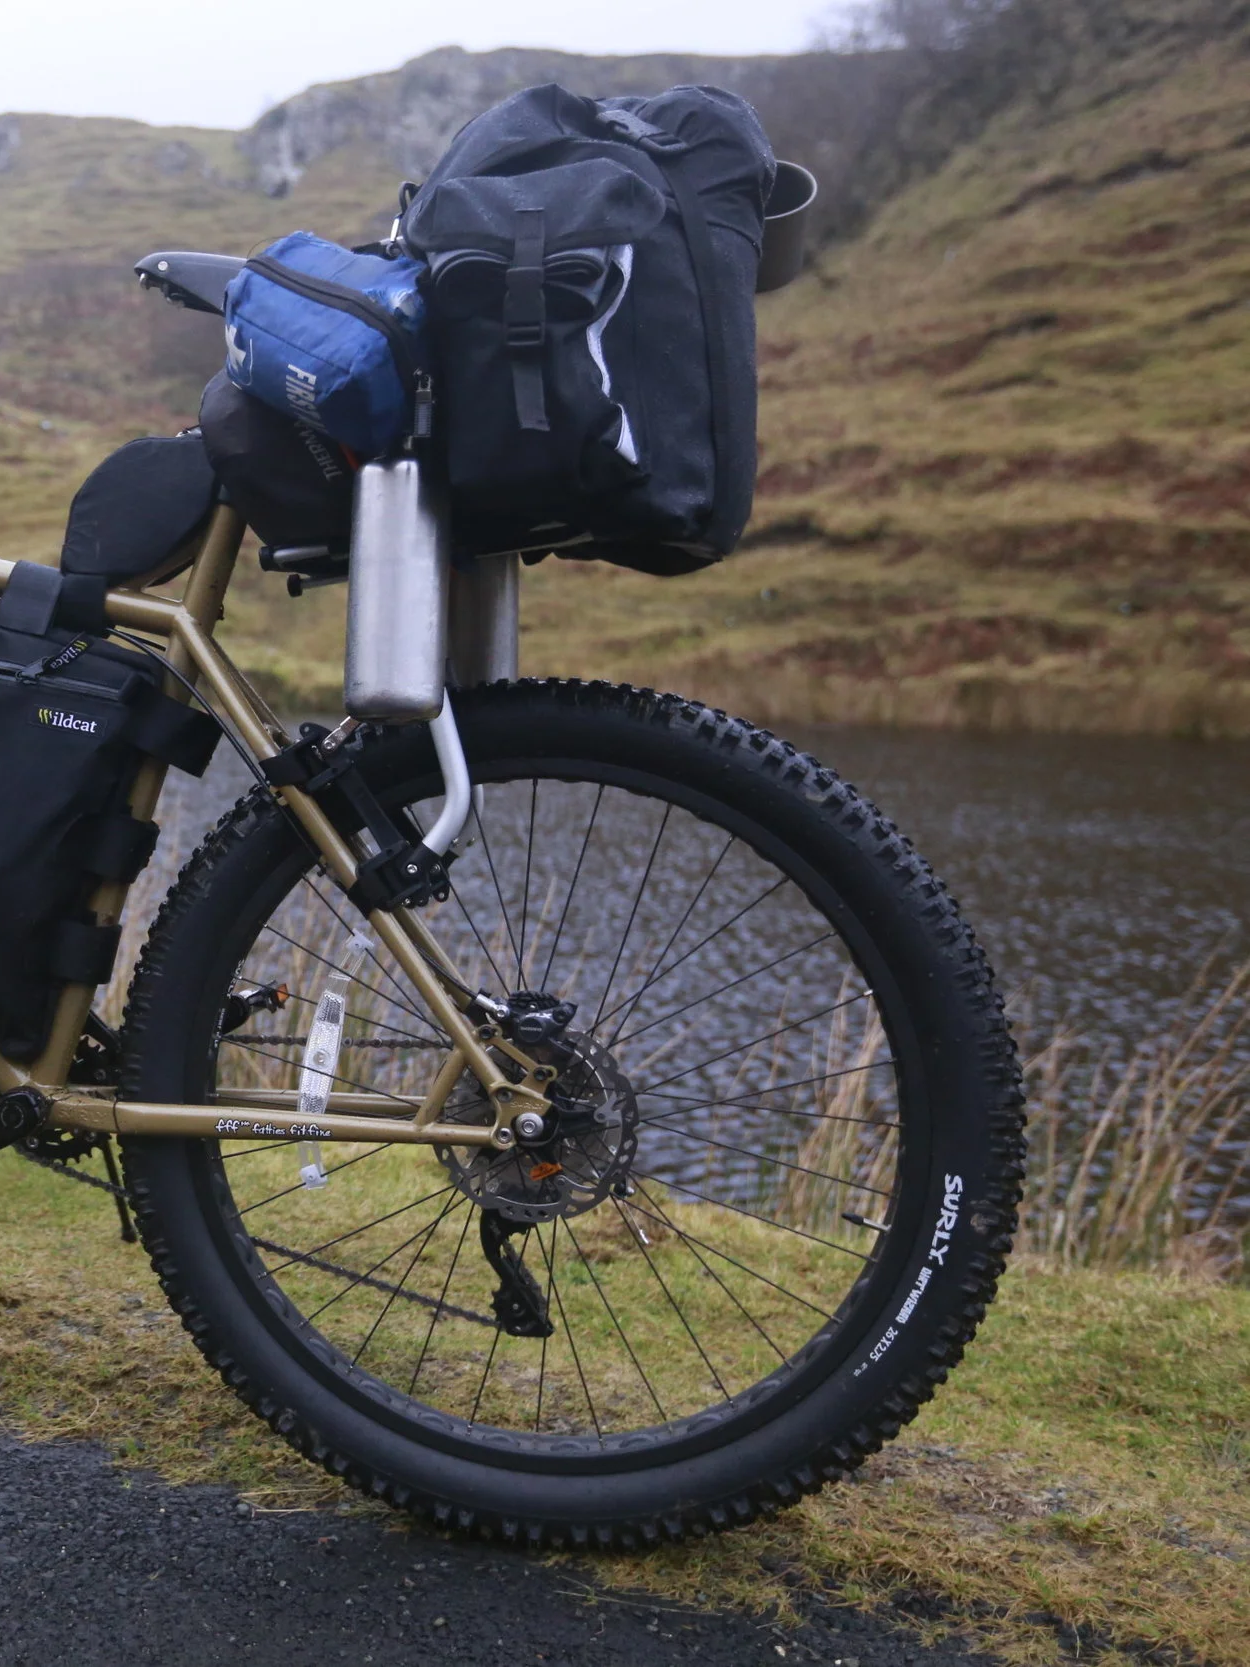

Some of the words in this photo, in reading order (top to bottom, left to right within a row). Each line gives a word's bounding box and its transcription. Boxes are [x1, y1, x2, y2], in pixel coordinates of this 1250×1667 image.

[38, 708, 97, 733] Wildcat
[252, 1123, 286, 1135] fatties
[290, 1124, 307, 1135] fit
[307, 1124, 331, 1137] fine
[929, 1173, 963, 1266] SURLY
